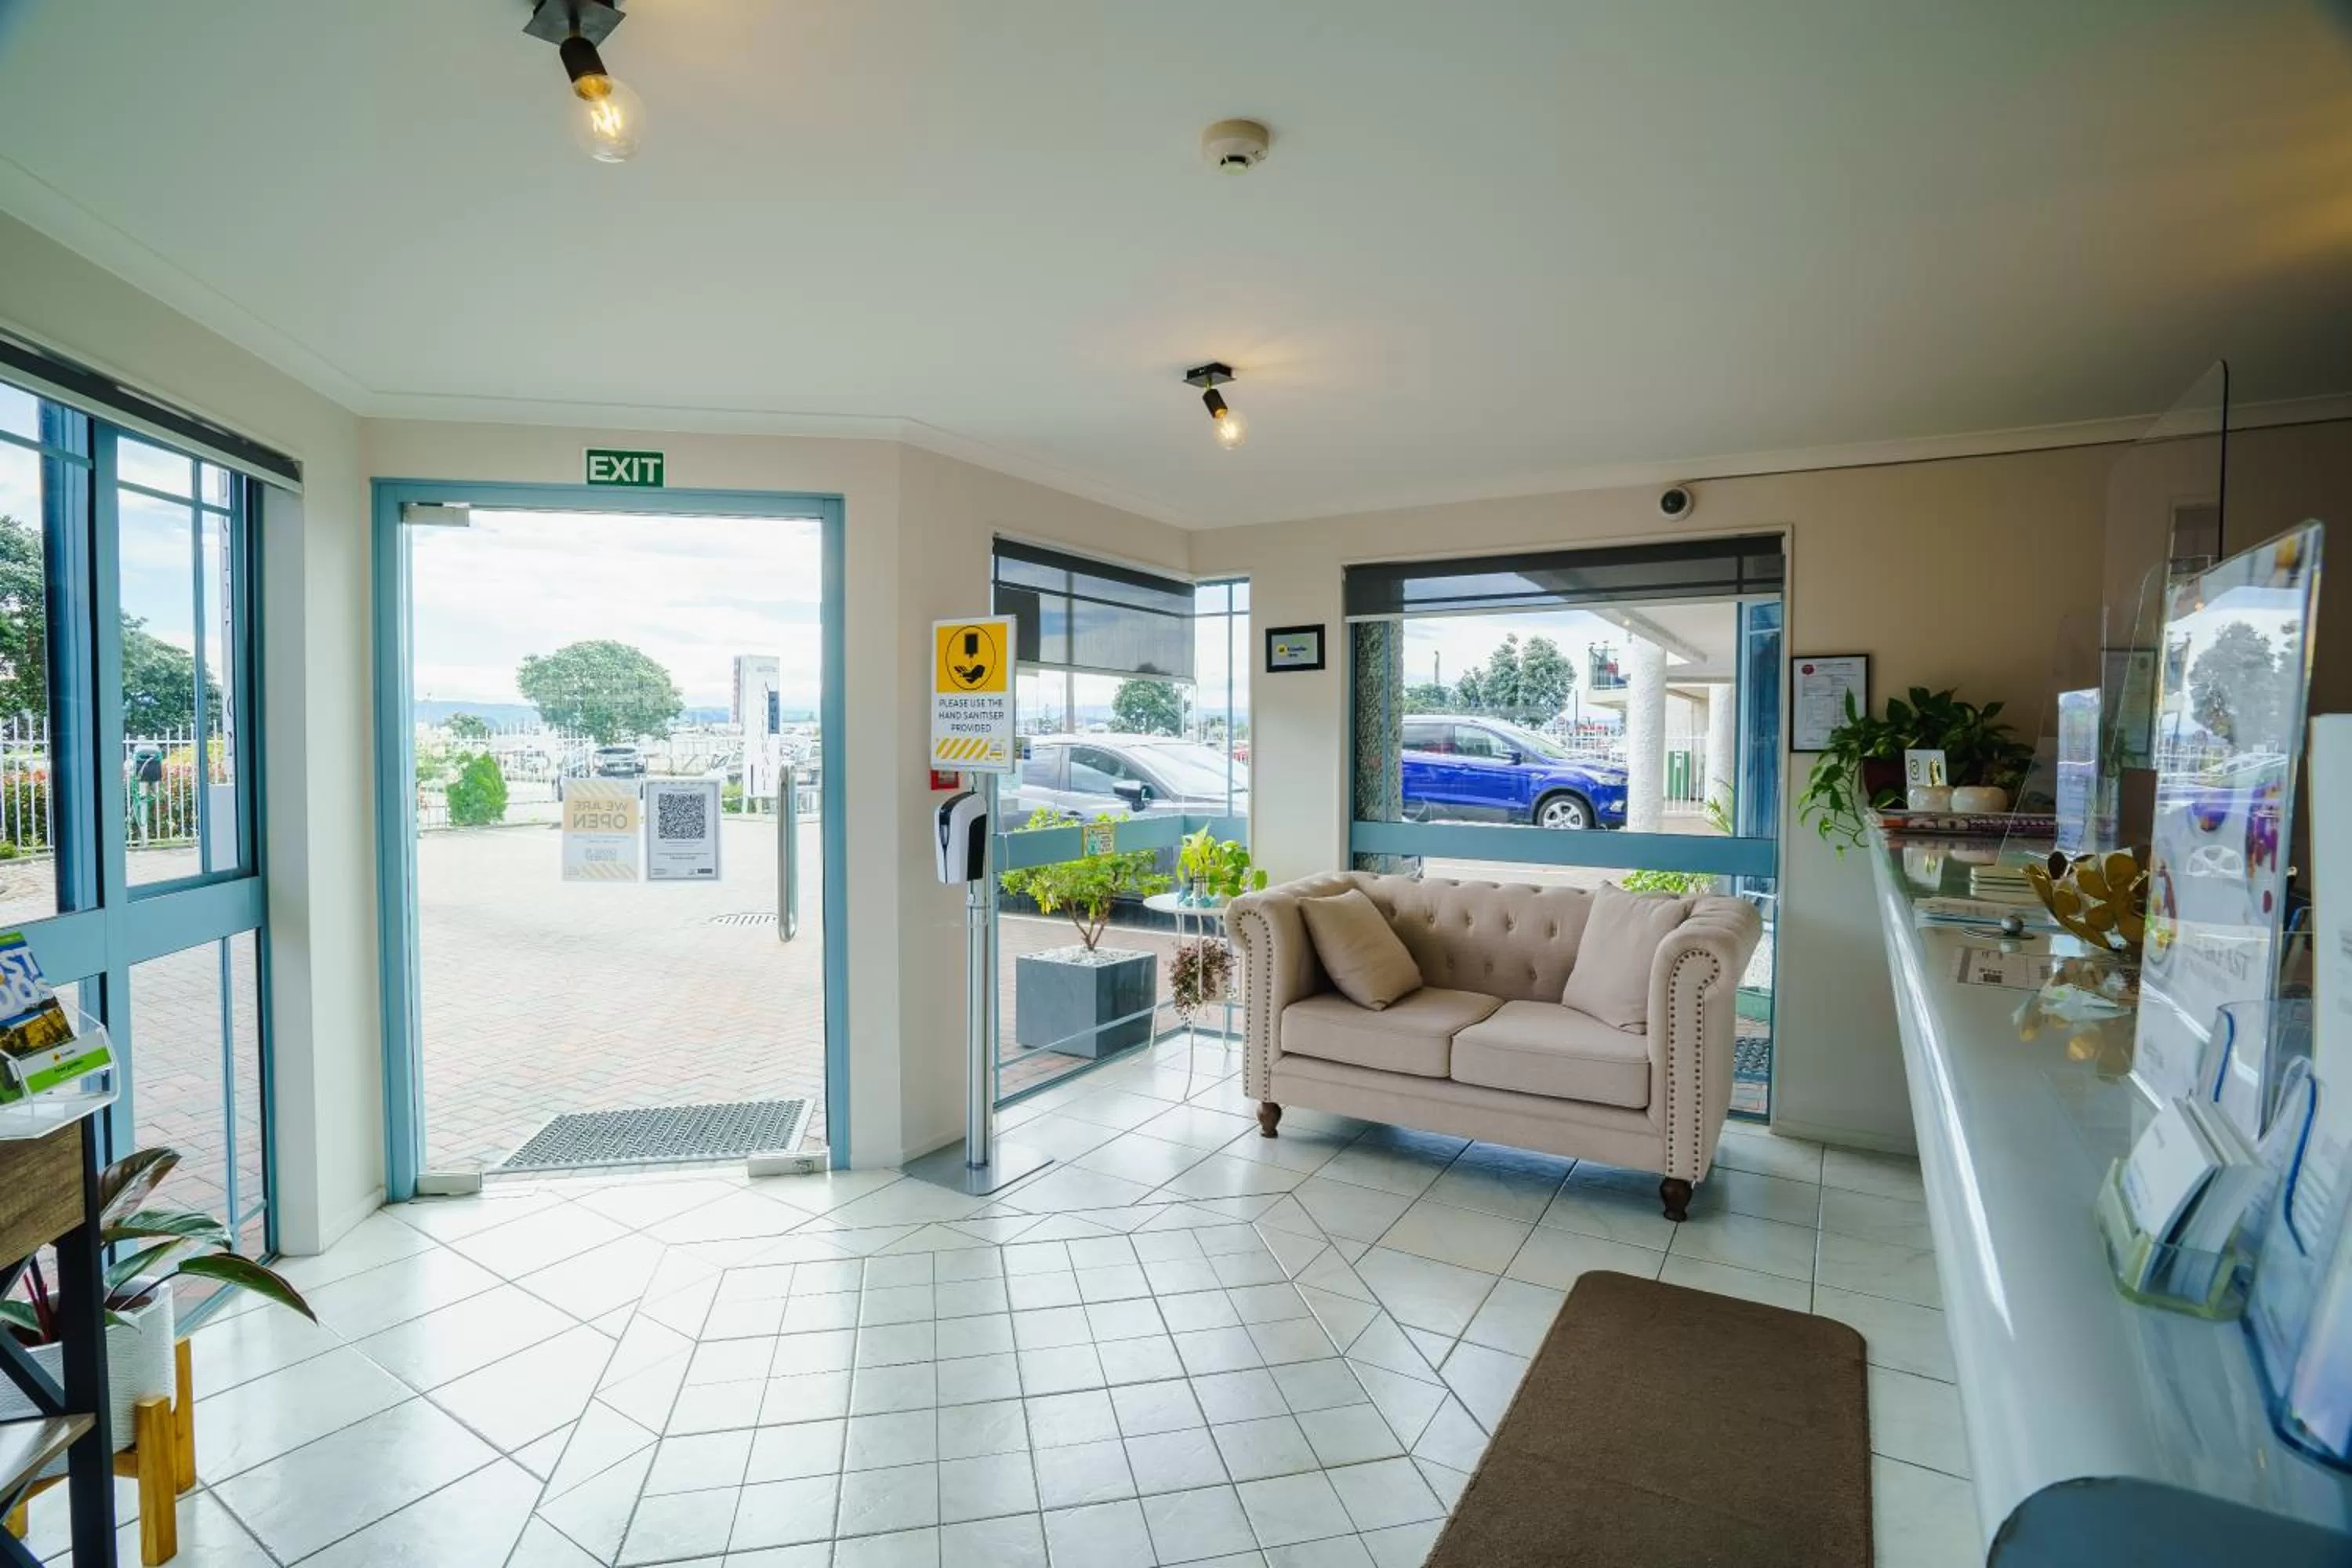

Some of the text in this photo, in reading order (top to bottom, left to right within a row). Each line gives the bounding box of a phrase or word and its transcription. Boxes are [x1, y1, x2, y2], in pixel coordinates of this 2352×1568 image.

[589, 456, 662, 482] EXIT
[939, 699, 1004, 707] PLEASE USE THE
[938, 711, 1004, 720] HAND SANITISER
[950, 724, 992, 733] PROVIDED
